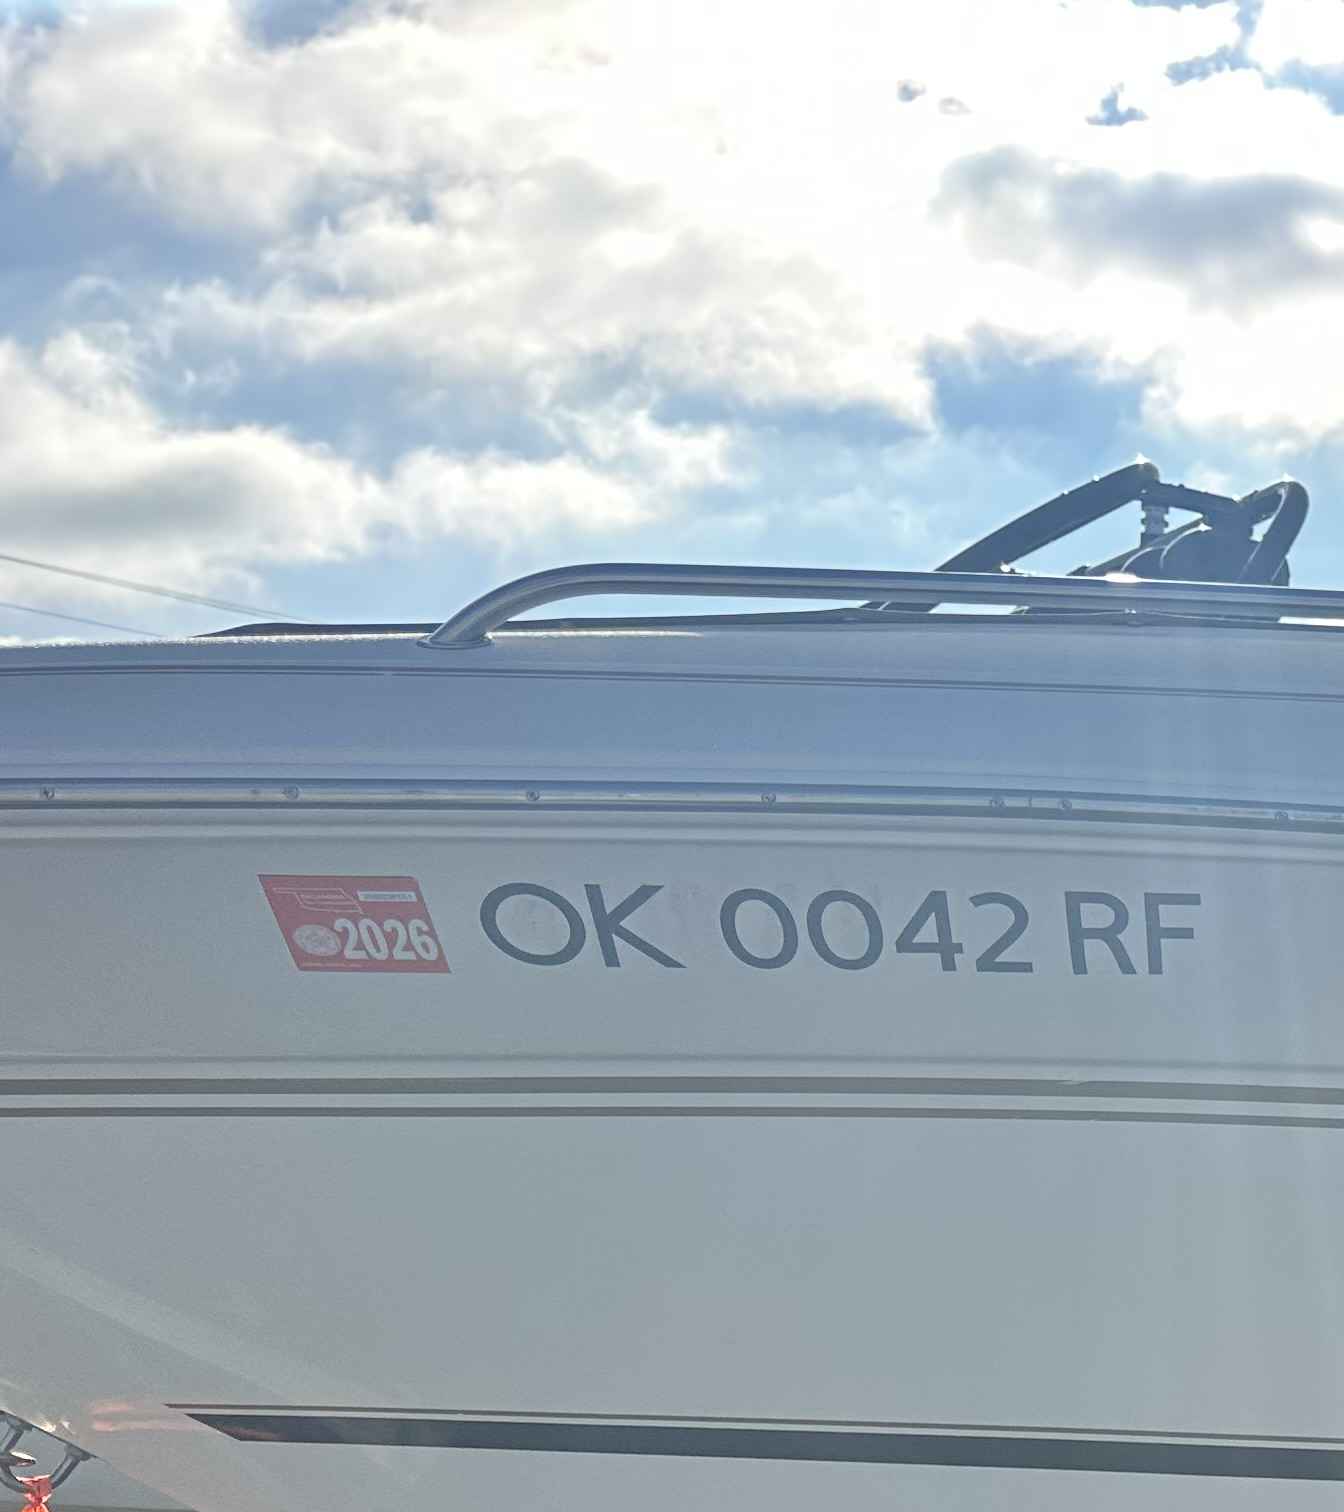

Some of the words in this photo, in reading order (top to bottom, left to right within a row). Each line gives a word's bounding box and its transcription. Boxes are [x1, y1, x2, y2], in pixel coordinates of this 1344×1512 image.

[334, 918, 439, 961] 2026
[480, 882, 687, 968] OK
[720, 888, 1034, 972] 0042
[1064, 890, 1201, 976] RF
